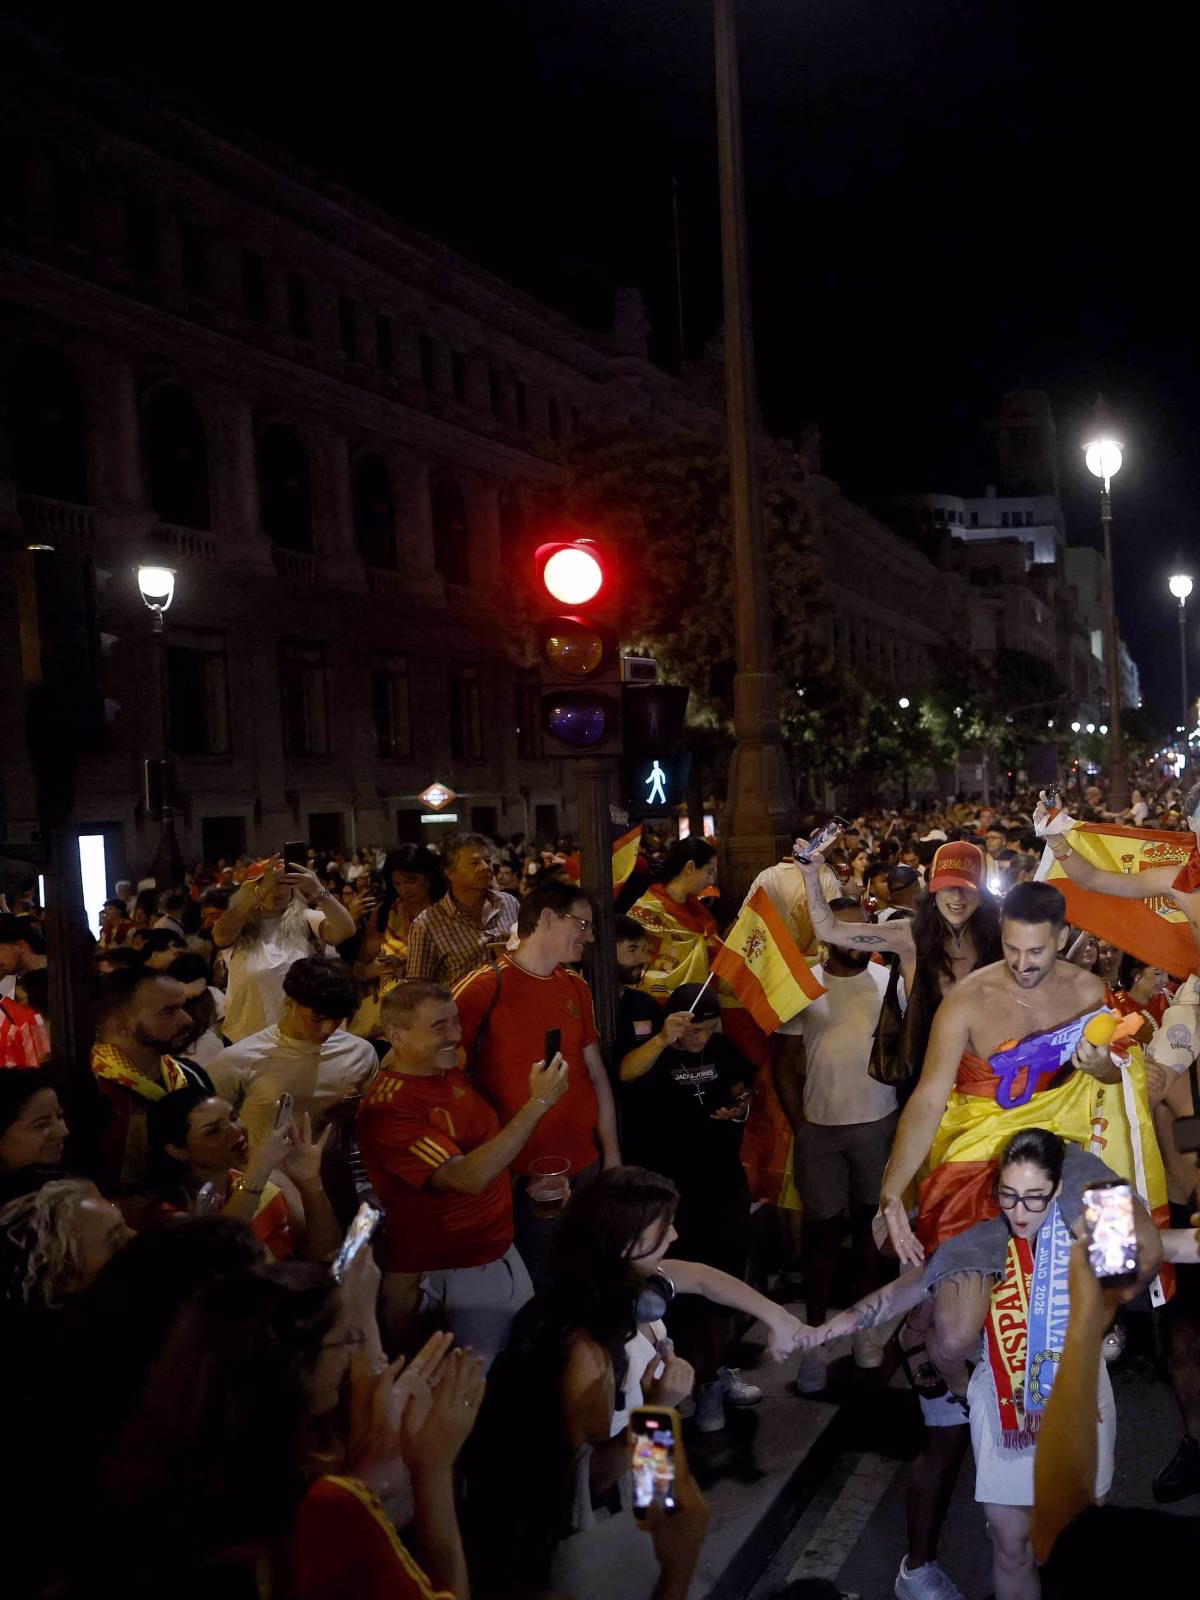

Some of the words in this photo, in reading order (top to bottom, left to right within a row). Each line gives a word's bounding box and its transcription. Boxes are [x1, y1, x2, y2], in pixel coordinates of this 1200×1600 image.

[1041, 1225, 1051, 1240] 19
[1038, 1247, 1049, 1280] JULIO
[1034, 1285, 1046, 1316] 2026
